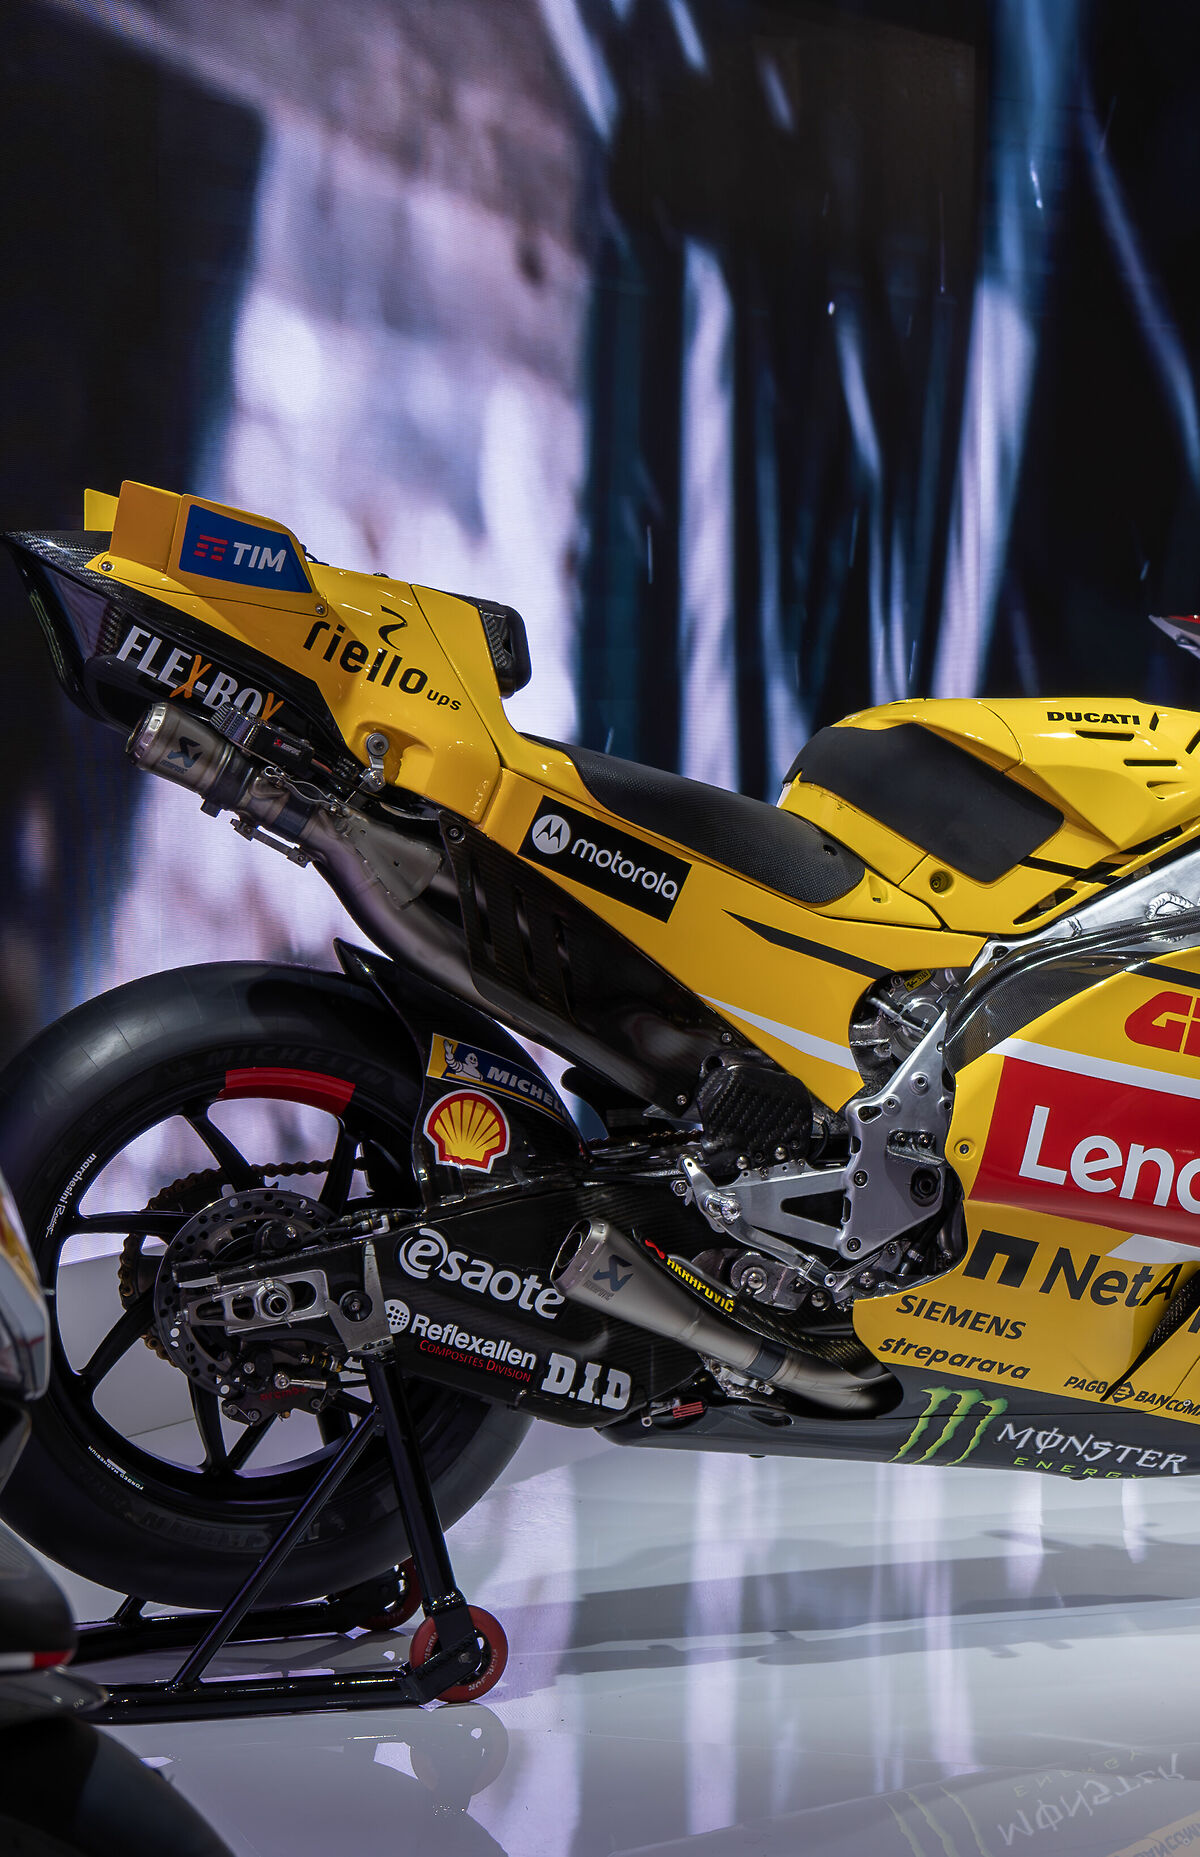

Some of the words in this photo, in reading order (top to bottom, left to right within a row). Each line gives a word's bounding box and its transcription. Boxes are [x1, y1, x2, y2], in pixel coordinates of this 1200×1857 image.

[232, 541, 287, 573] TIM
[302, 620, 429, 696] riello
[426, 687, 463, 713] ups
[1046, 711, 1141, 727] DUCATI
[570, 837, 679, 901] motorola
[60, 1152, 97, 1204] marchesini
[399, 1227, 566, 1320] esaote
[409, 1313, 538, 1371] Reflexallen
[895, 1294, 1027, 1341] SIEMENS
[876, 1335, 1031, 1382] streparava
[1062, 1375, 1110, 1396] PAGO
